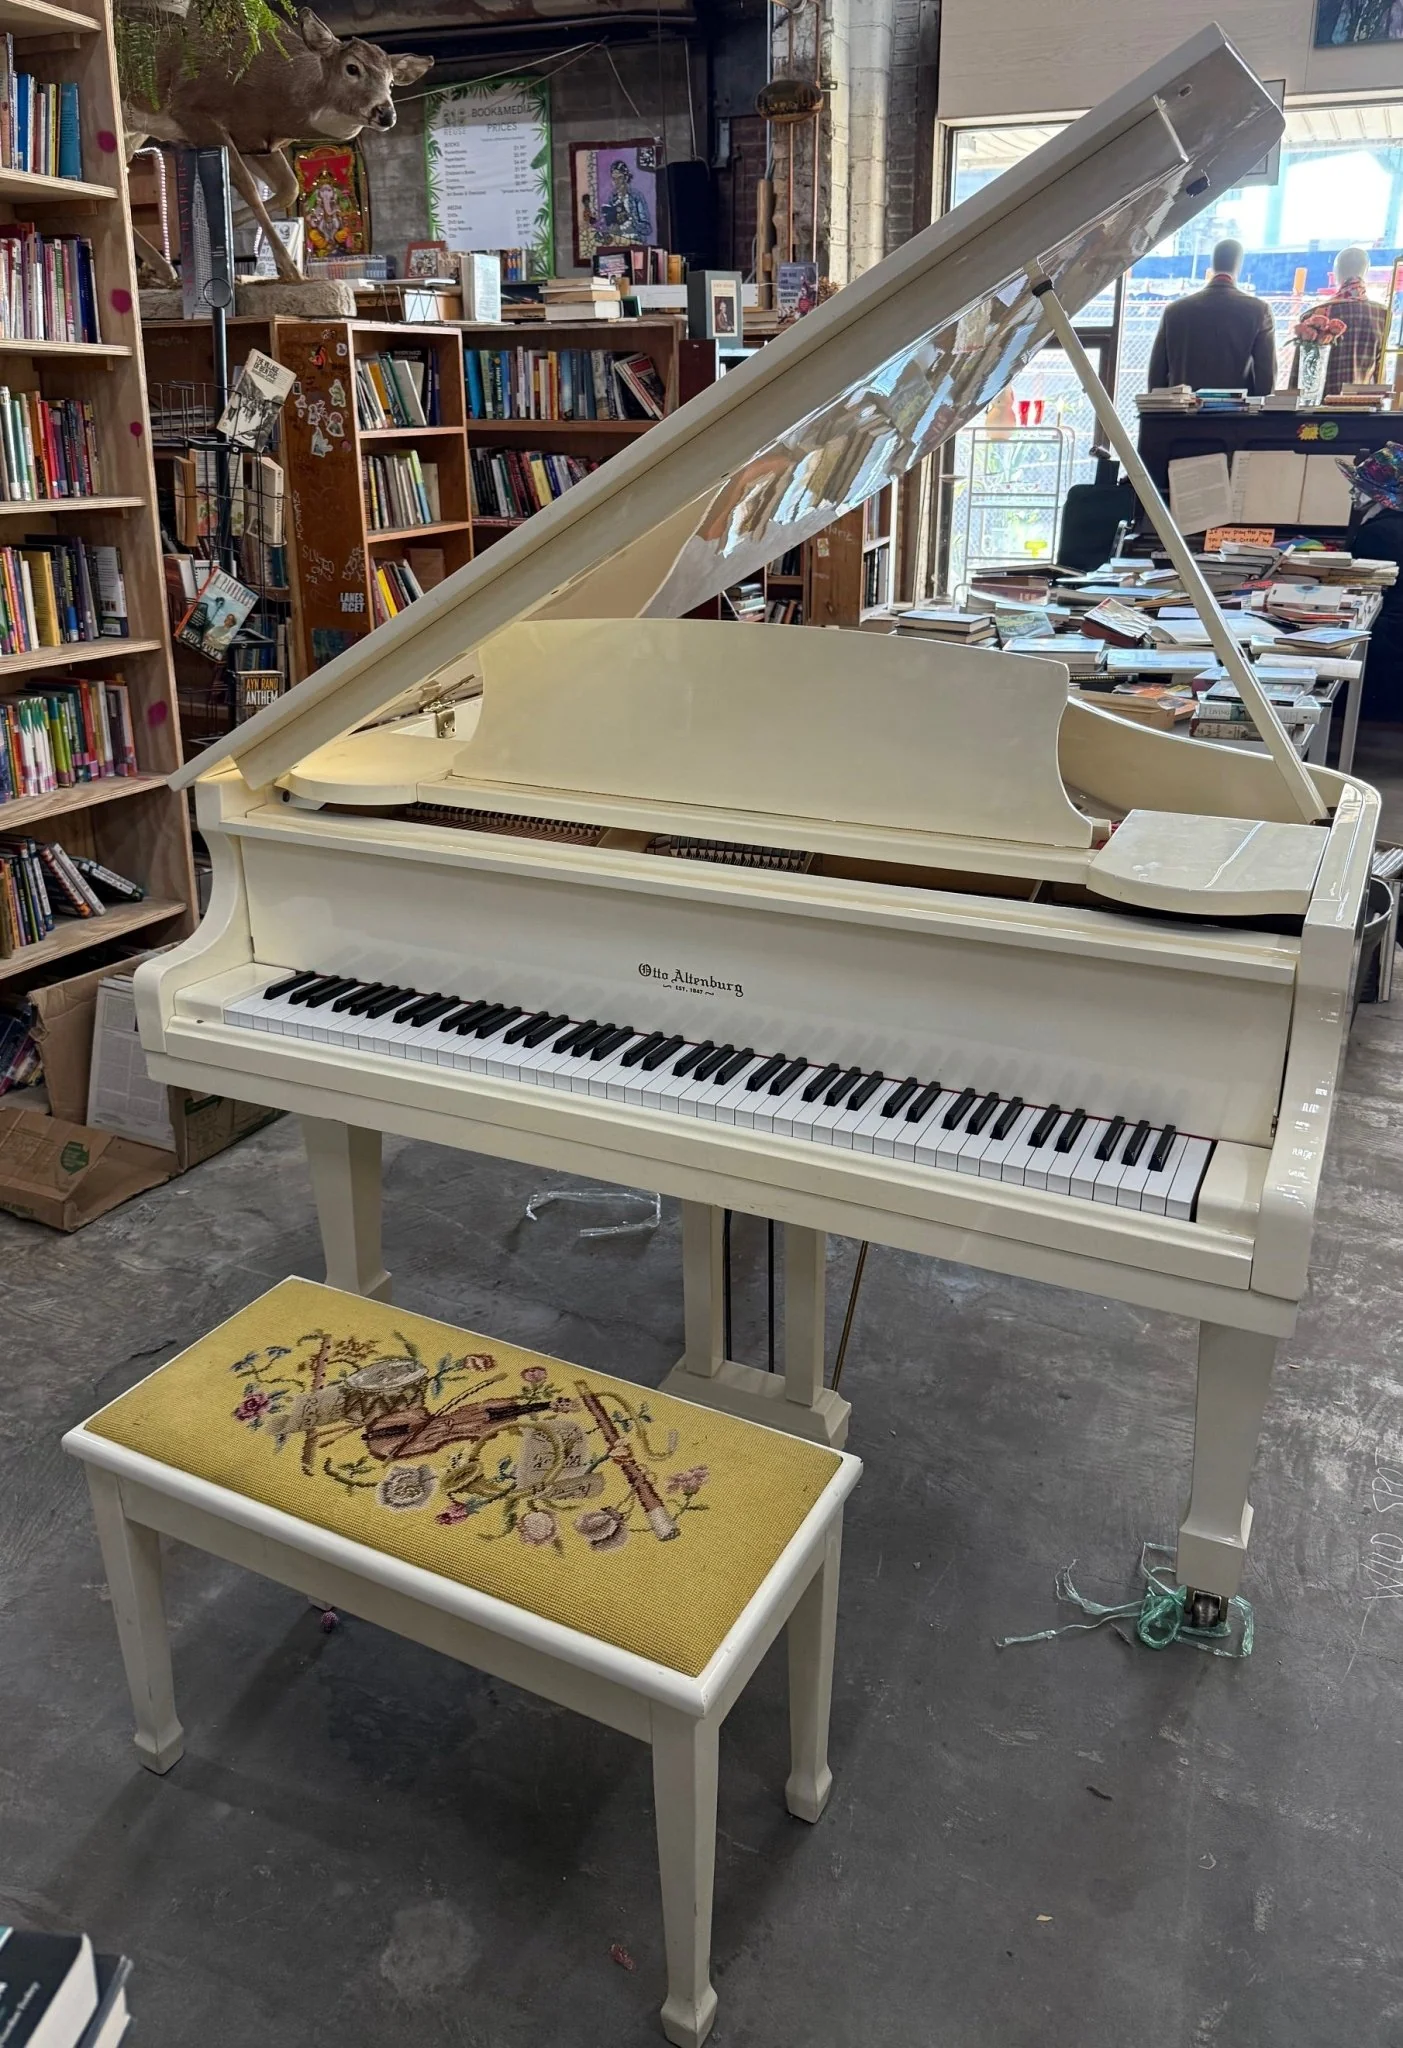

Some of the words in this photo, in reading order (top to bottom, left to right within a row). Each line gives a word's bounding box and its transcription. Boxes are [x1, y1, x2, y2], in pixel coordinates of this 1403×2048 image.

[487, 121, 518, 133] PRICES
[246, 678, 260, 690] AYN
[261, 677, 279, 690] RAND
[246, 690, 279, 705] ANTHEM
[638, 962, 669, 981] Otto
[671, 968, 744, 998] Altenburg
[675, 985, 688, 993] EST.
[690, 987, 703, 995] 1847
